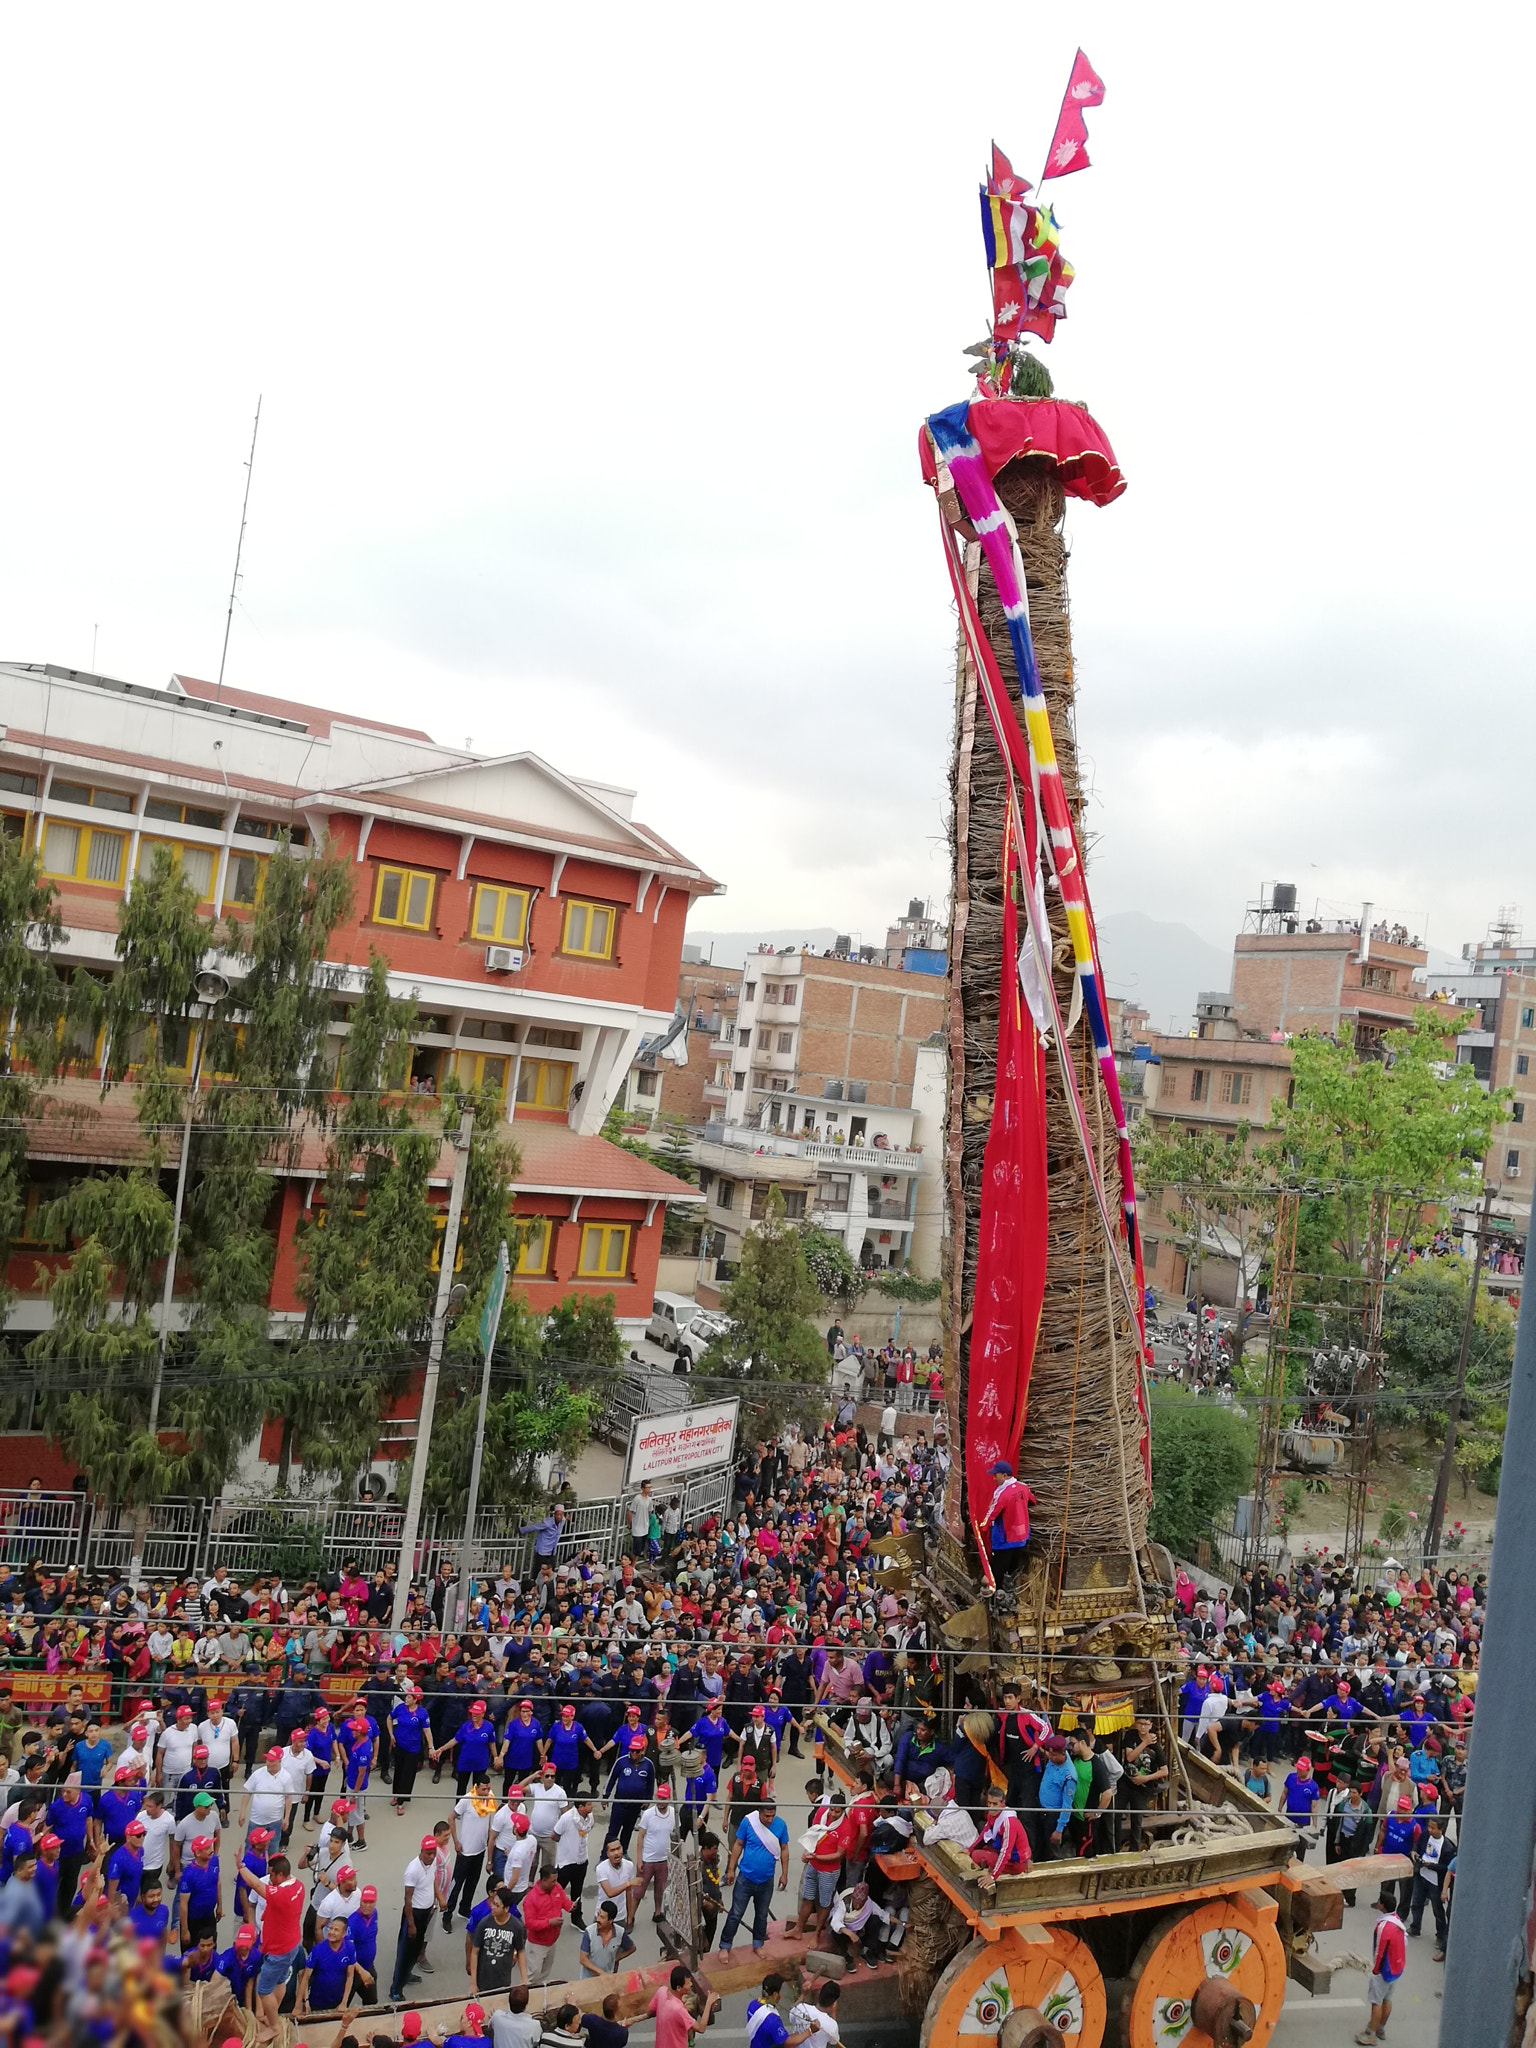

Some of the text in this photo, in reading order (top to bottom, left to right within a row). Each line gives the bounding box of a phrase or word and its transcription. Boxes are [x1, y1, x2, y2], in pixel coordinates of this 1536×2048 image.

[639, 1431, 677, 1450] ललितपुर
[643, 1457, 673, 1471] LALITPUR
[673, 1447, 712, 1464] METROPOLITAN
[712, 1445, 725, 1454] CITY
[484, 1927, 514, 1944] ZOO YORK
